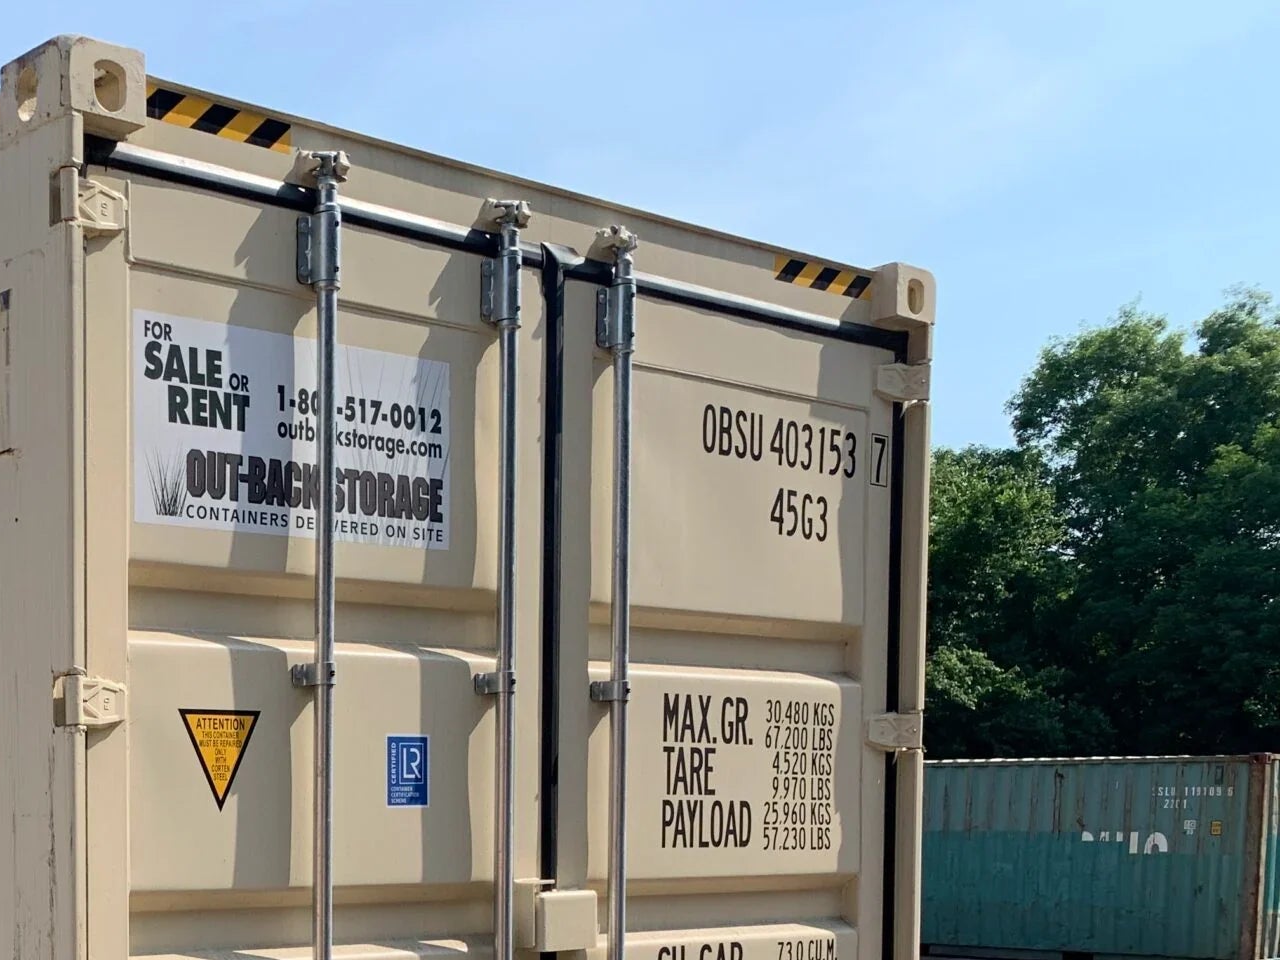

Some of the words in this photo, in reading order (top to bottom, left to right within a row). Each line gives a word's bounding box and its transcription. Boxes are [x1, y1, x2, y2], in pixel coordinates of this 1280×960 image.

[144, 319, 172, 342] FOR
[144, 341, 223, 388] SALE
[229, 372, 249, 393] OR
[168, 385, 250, 432] RENT
[277, 385, 442, 435] 1-80-517-0012
[278, 417, 443, 459] outbkstorage.com
[702, 404, 763, 461] OBSU
[770, 418, 857, 478] 403153
[874, 437, 887, 483] 7
[334, 466, 444, 523] STORAGE
[770, 488, 828, 541] 45G3
[186, 504, 288, 528] CONTAINERS
[296, 517, 379, 536] DEVERED
[386, 525, 406, 539] ON
[413, 526, 444, 542] SITE
[196, 718, 245, 730] ATTENTION
[213, 731, 239, 739] CONTAINER
[663, 693, 717, 744] MAX.
[721, 696, 753, 745] GR.
[766, 699, 809, 725] 30,480
[813, 703, 834, 726] KGS
[765, 726, 808, 750] 67,200
[812, 728, 832, 751] LBS
[220, 740, 242, 748] REPAIRED
[403, 748, 421, 778] LR
[213, 773, 228, 781] STEEL
[663, 746, 716, 795] TARE
[772, 751, 807, 775] 4,520
[811, 753, 832, 776] KGS
[772, 777, 806, 800] 9,970
[811, 777, 831, 800] LBS
[661, 799, 752, 848] PAYLOAD
[763, 801, 806, 825] 25,960
[810, 802, 831, 825] KGS
[763, 827, 806, 850] 57,230
[810, 827, 831, 850] LBS
